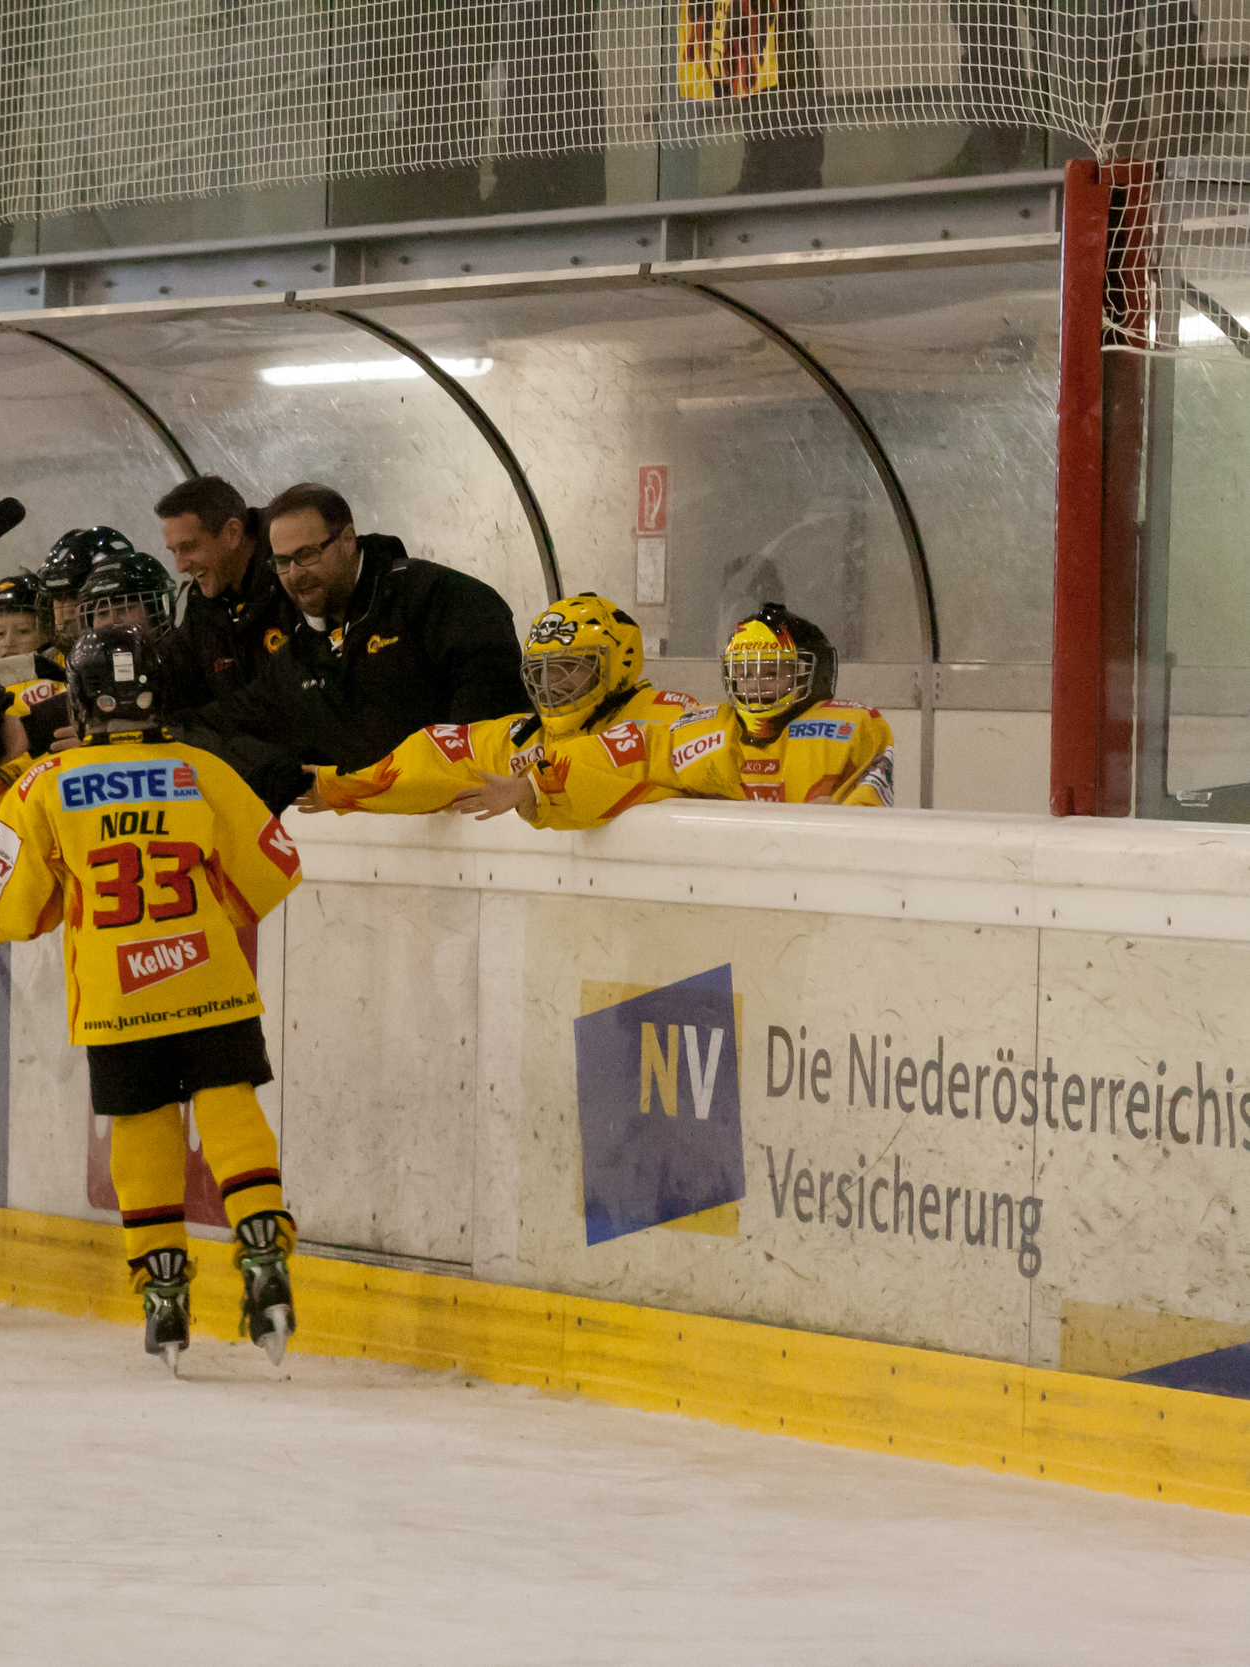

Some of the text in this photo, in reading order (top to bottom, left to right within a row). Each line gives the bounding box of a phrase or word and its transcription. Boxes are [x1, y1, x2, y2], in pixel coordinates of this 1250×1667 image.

[62, 768, 168, 807] ERSTE
[173, 788, 200, 797] BANK
[101, 810, 170, 842] NOLL
[86, 841, 205, 930] 33
[127, 939, 198, 979] Kelly's
[84, 991, 258, 1032] www.junior-capitals.at
[639, 1021, 724, 1120] NV
[766, 1024, 832, 1105] Die
[766, 1145, 1044, 1279] Versicherung
